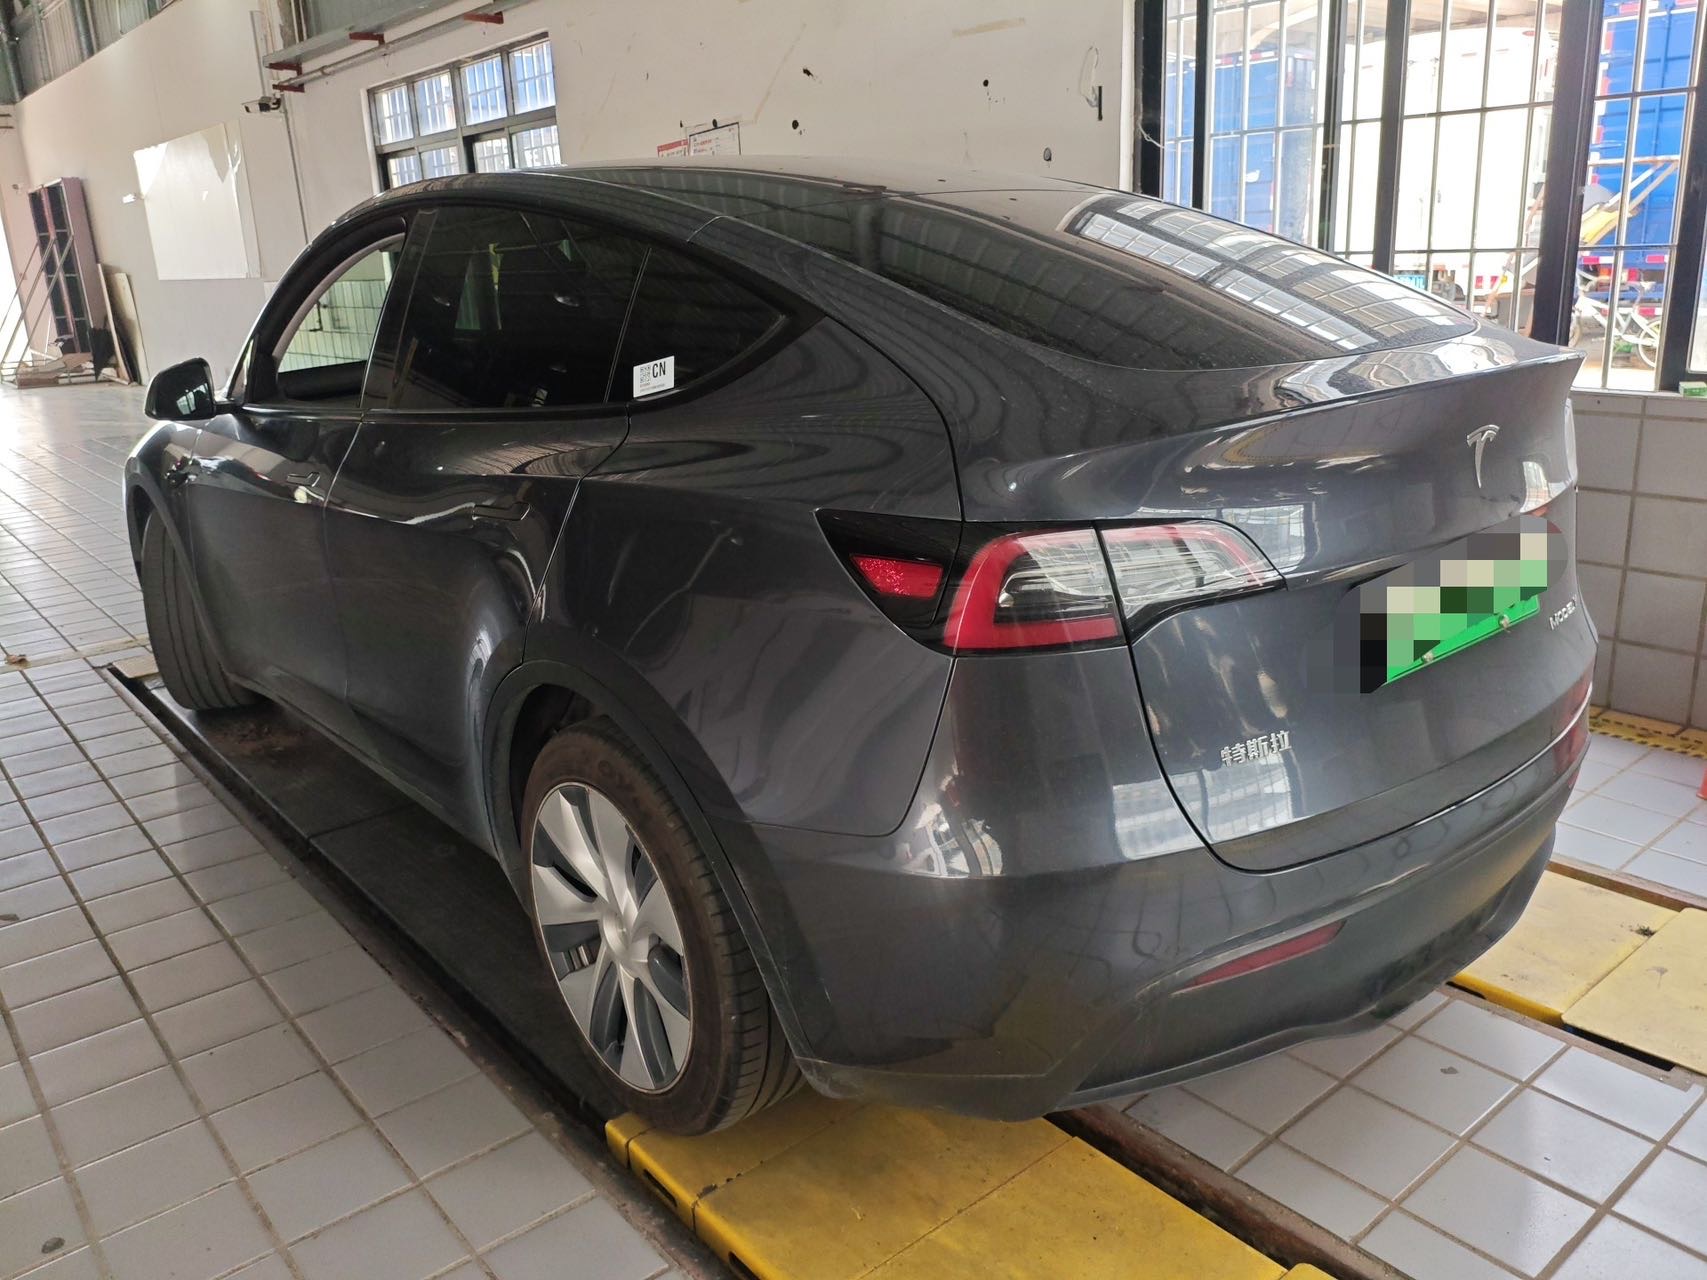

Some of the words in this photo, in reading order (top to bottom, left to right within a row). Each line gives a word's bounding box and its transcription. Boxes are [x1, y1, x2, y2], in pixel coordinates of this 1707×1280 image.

[652, 361, 666, 378] CN
[1220, 730, 1292, 767] 特斯拉
